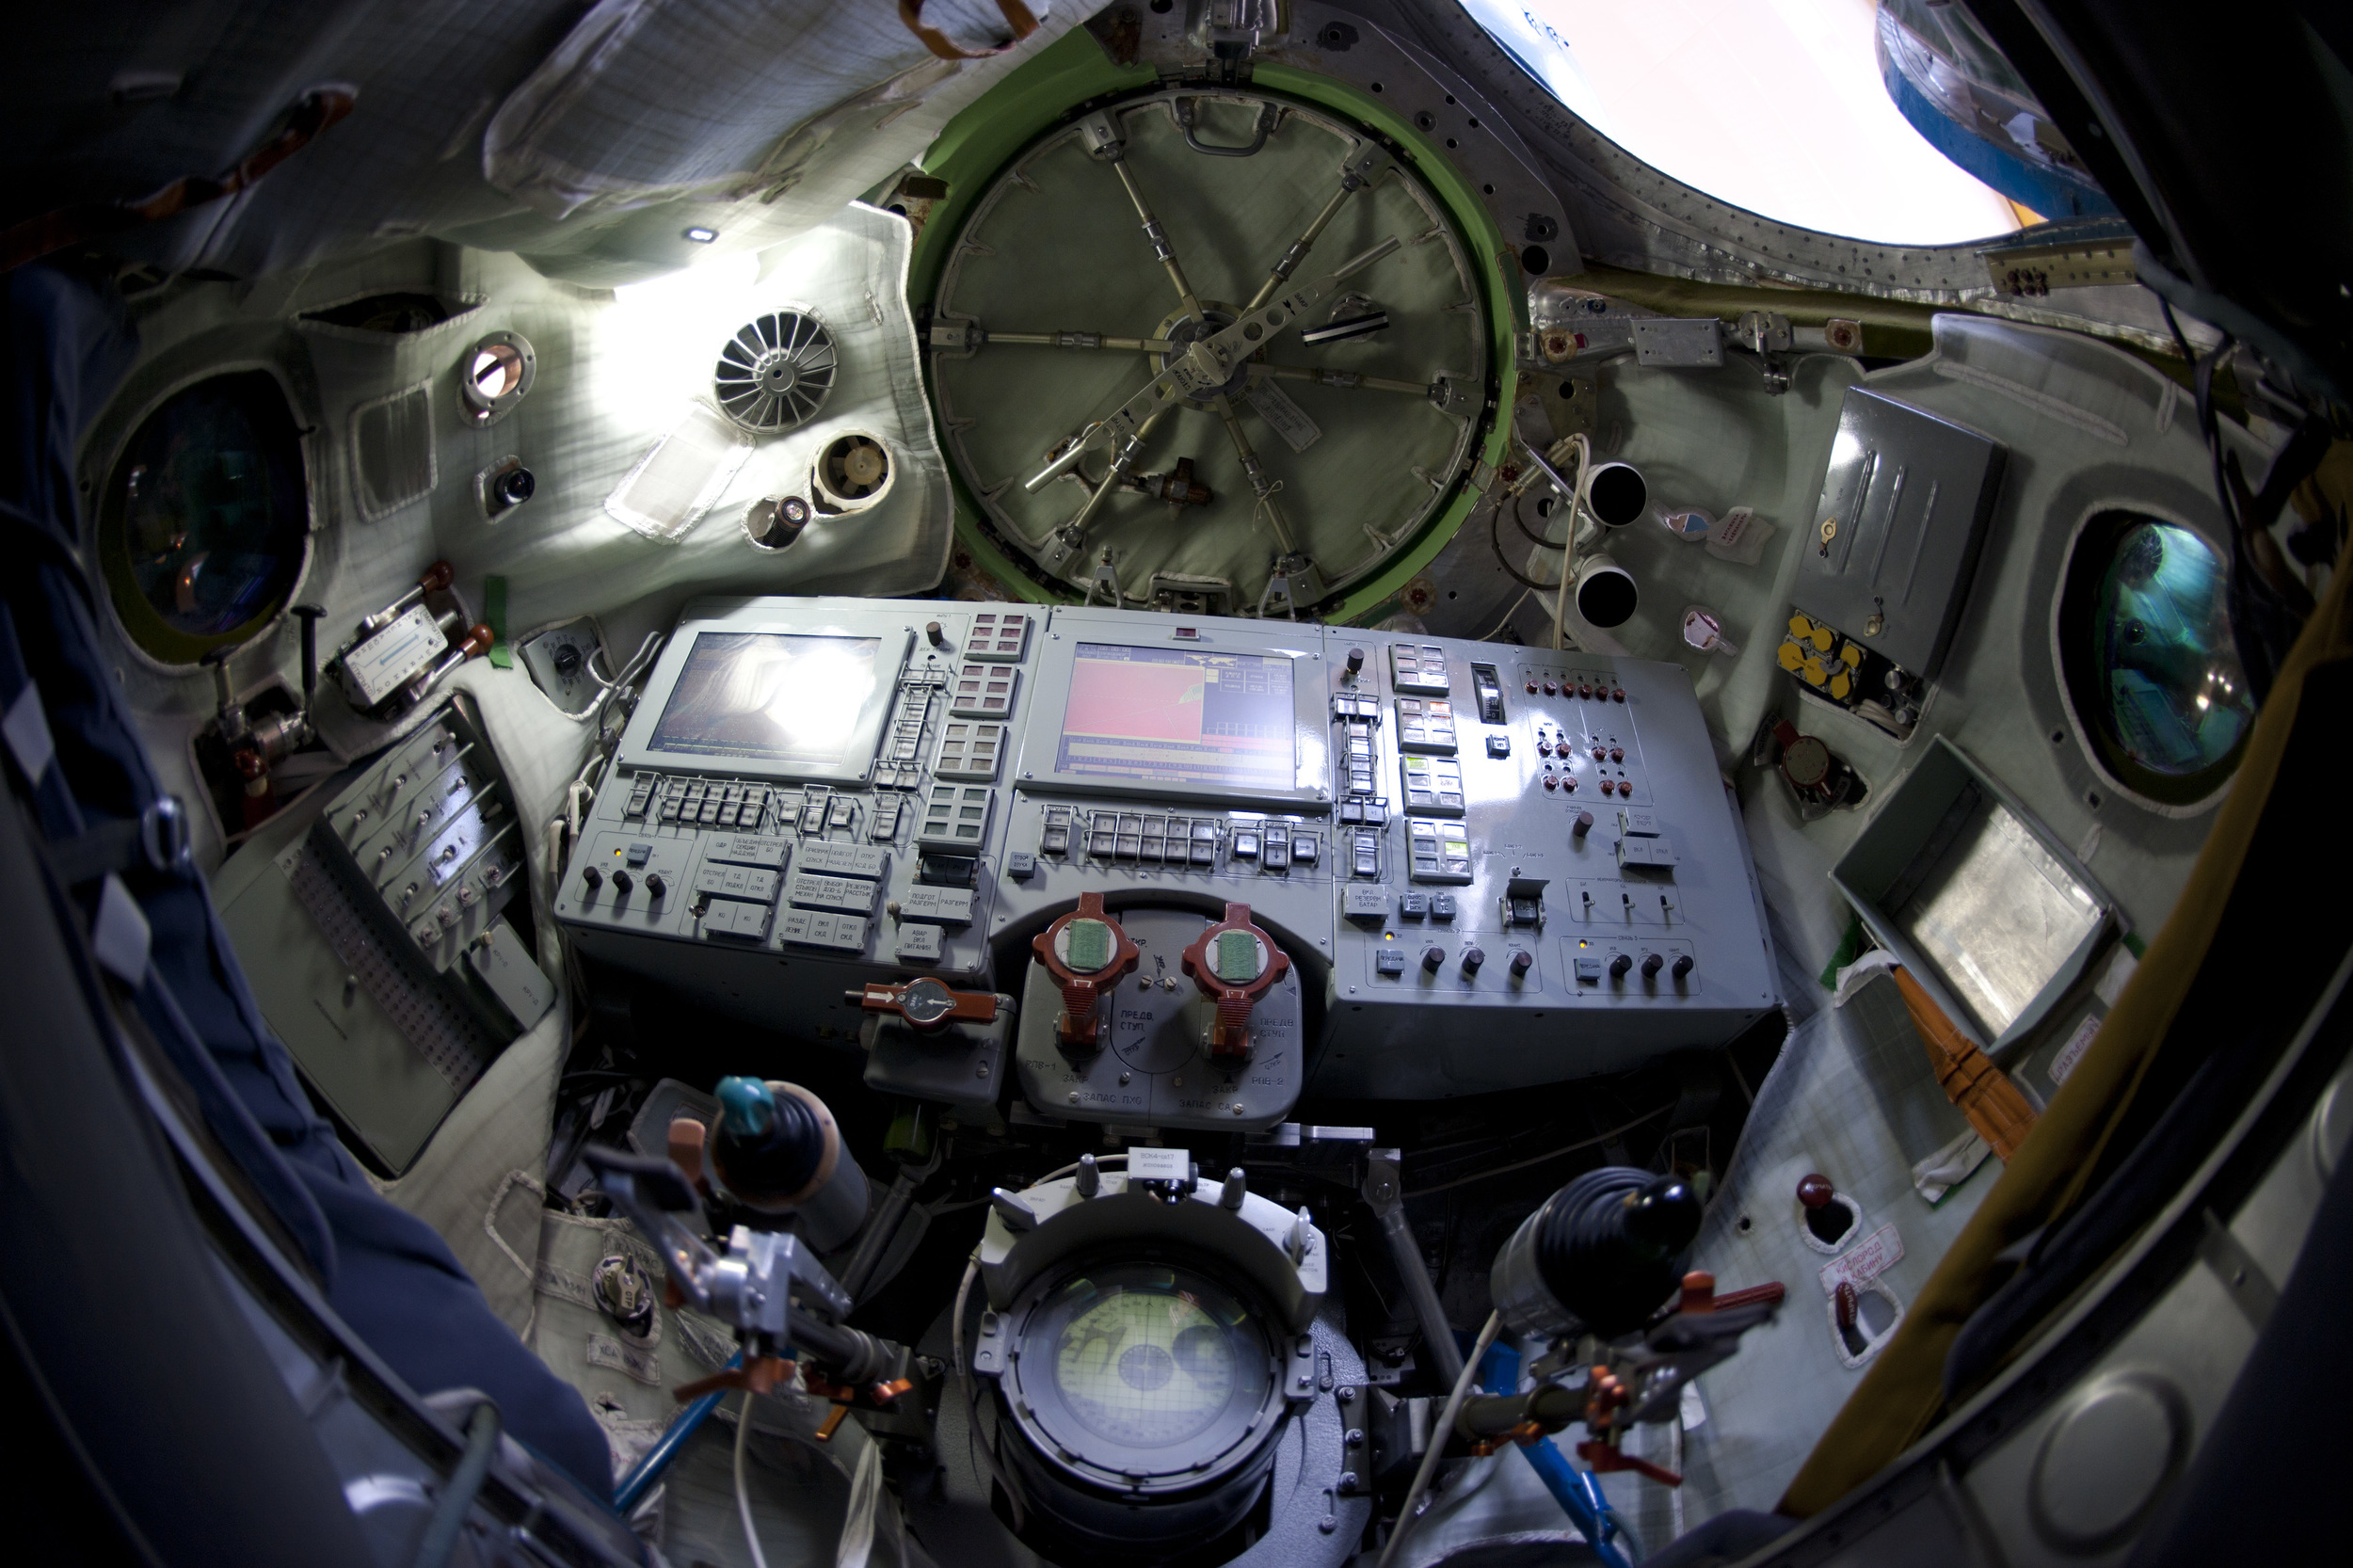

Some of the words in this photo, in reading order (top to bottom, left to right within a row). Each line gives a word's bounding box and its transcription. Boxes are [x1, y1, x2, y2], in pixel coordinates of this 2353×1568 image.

[1294, 292, 1308, 309] ЗАКР
[1173, 369, 1191, 391] СТОПОР
[1112, 417, 1125, 432] ОТКР
[424, 611, 443, 640] ЗАКРЫТО
[1260, 1017, 1294, 1027] ПРЕДВ
[1260, 1030, 1285, 1038] СТУП
[1025, 1061, 1056, 1070] РПВ-1
[1063, 1075, 1089, 1084] ЗАКР
[1251, 1077, 1284, 1086] РПВ-2
[1212, 1085, 1239, 1094] ЗАКР
[1083, 1093, 1115, 1103] ЗАПАС
[1122, 1096, 1142, 1105] ПХО
[1179, 1099, 1211, 1110] ЗАПАС
[1218, 1102, 1230, 1112] СА
[1836, 1241, 1882, 1275] КИСЛОРОД
[1851, 1254, 1883, 1283] КАБИНУ
[624, 1290, 633, 1307] СТР
